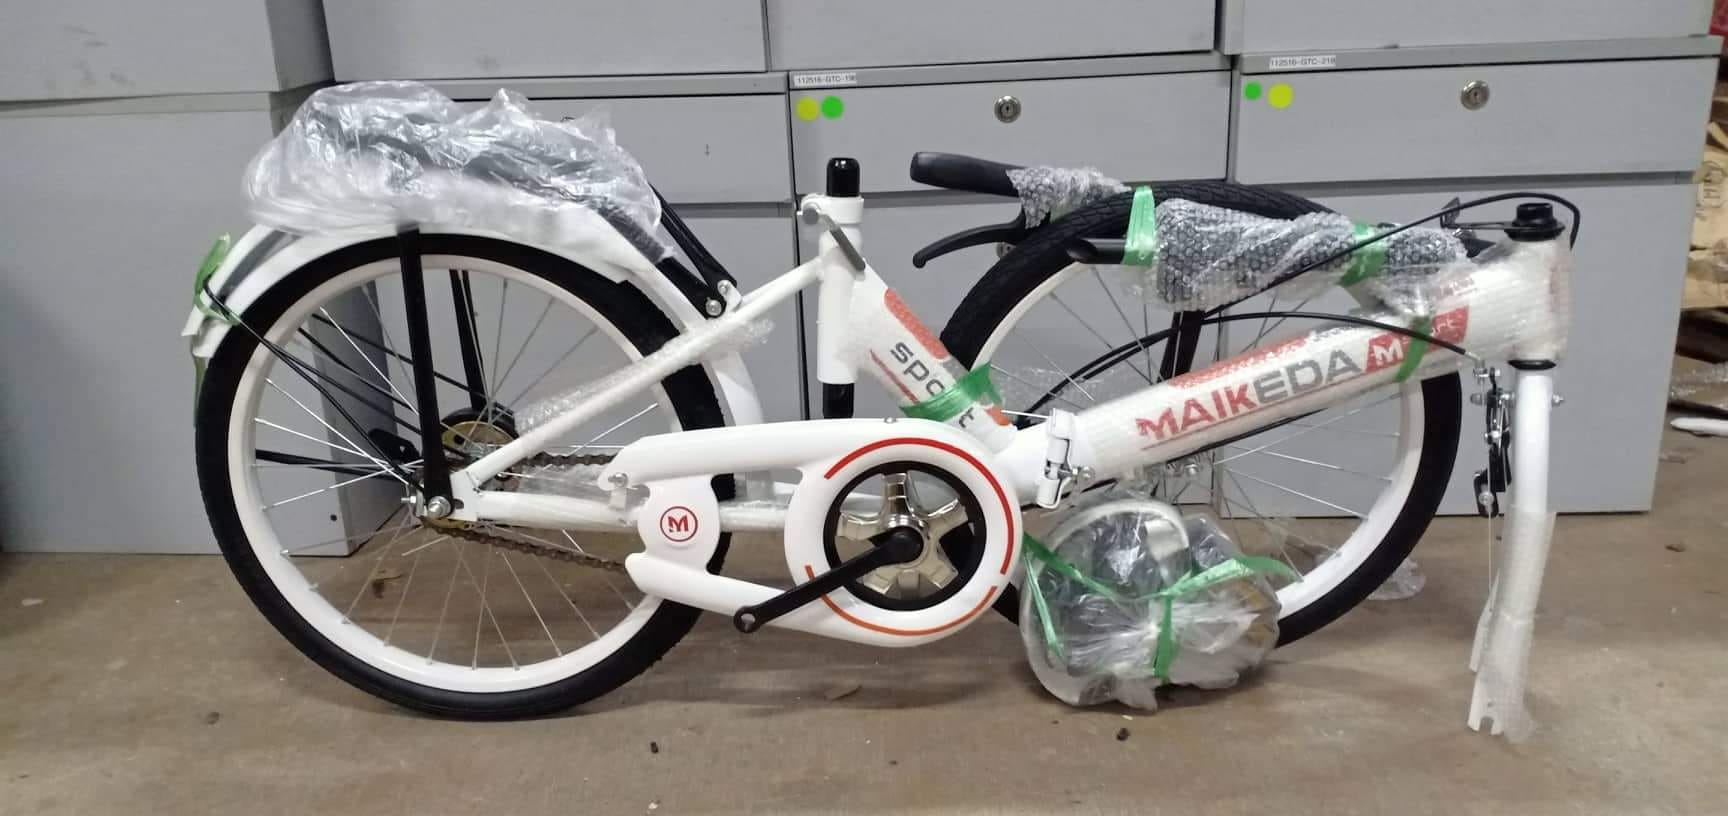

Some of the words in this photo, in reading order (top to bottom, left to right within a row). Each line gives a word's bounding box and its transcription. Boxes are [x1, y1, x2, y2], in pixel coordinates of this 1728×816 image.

[890, 341, 975, 429] spot
[1135, 348, 1363, 441] MAIKEDA
[1373, 338, 1404, 367] M
